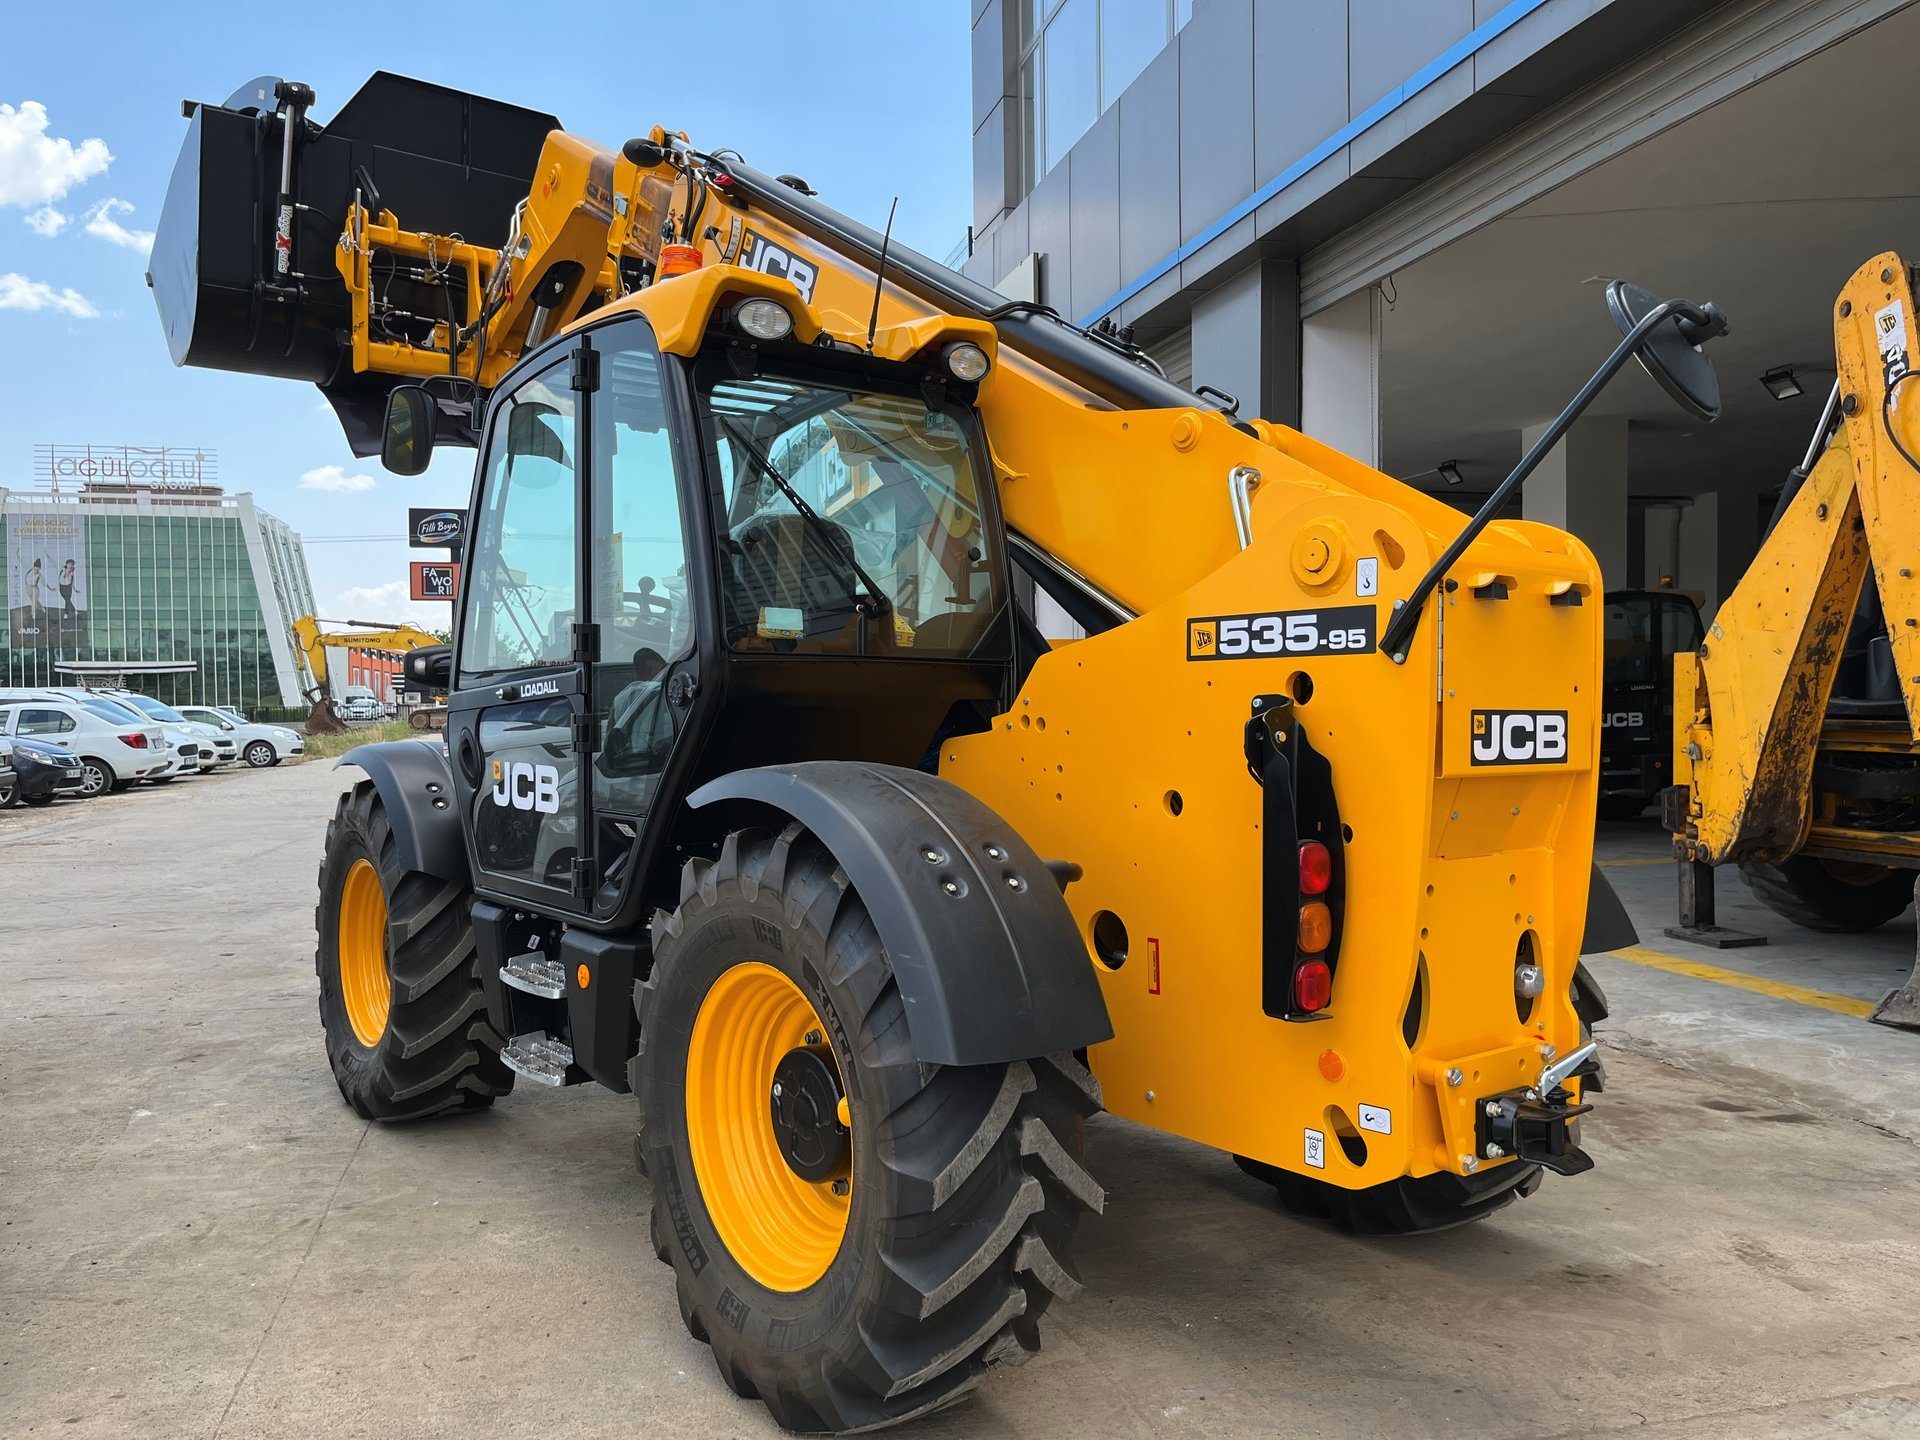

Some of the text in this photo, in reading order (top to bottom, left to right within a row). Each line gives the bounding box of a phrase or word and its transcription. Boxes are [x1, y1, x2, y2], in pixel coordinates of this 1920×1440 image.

[739, 238, 814, 304] JCB
[421, 521, 458, 534] Filli Boya
[1195, 614, 1367, 655] JCB 535-95
[520, 679, 560, 698] LOADALL
[1473, 714, 1567, 761] JCB
[1601, 712, 1644, 728] JCB
[492, 761, 560, 815] JCB
